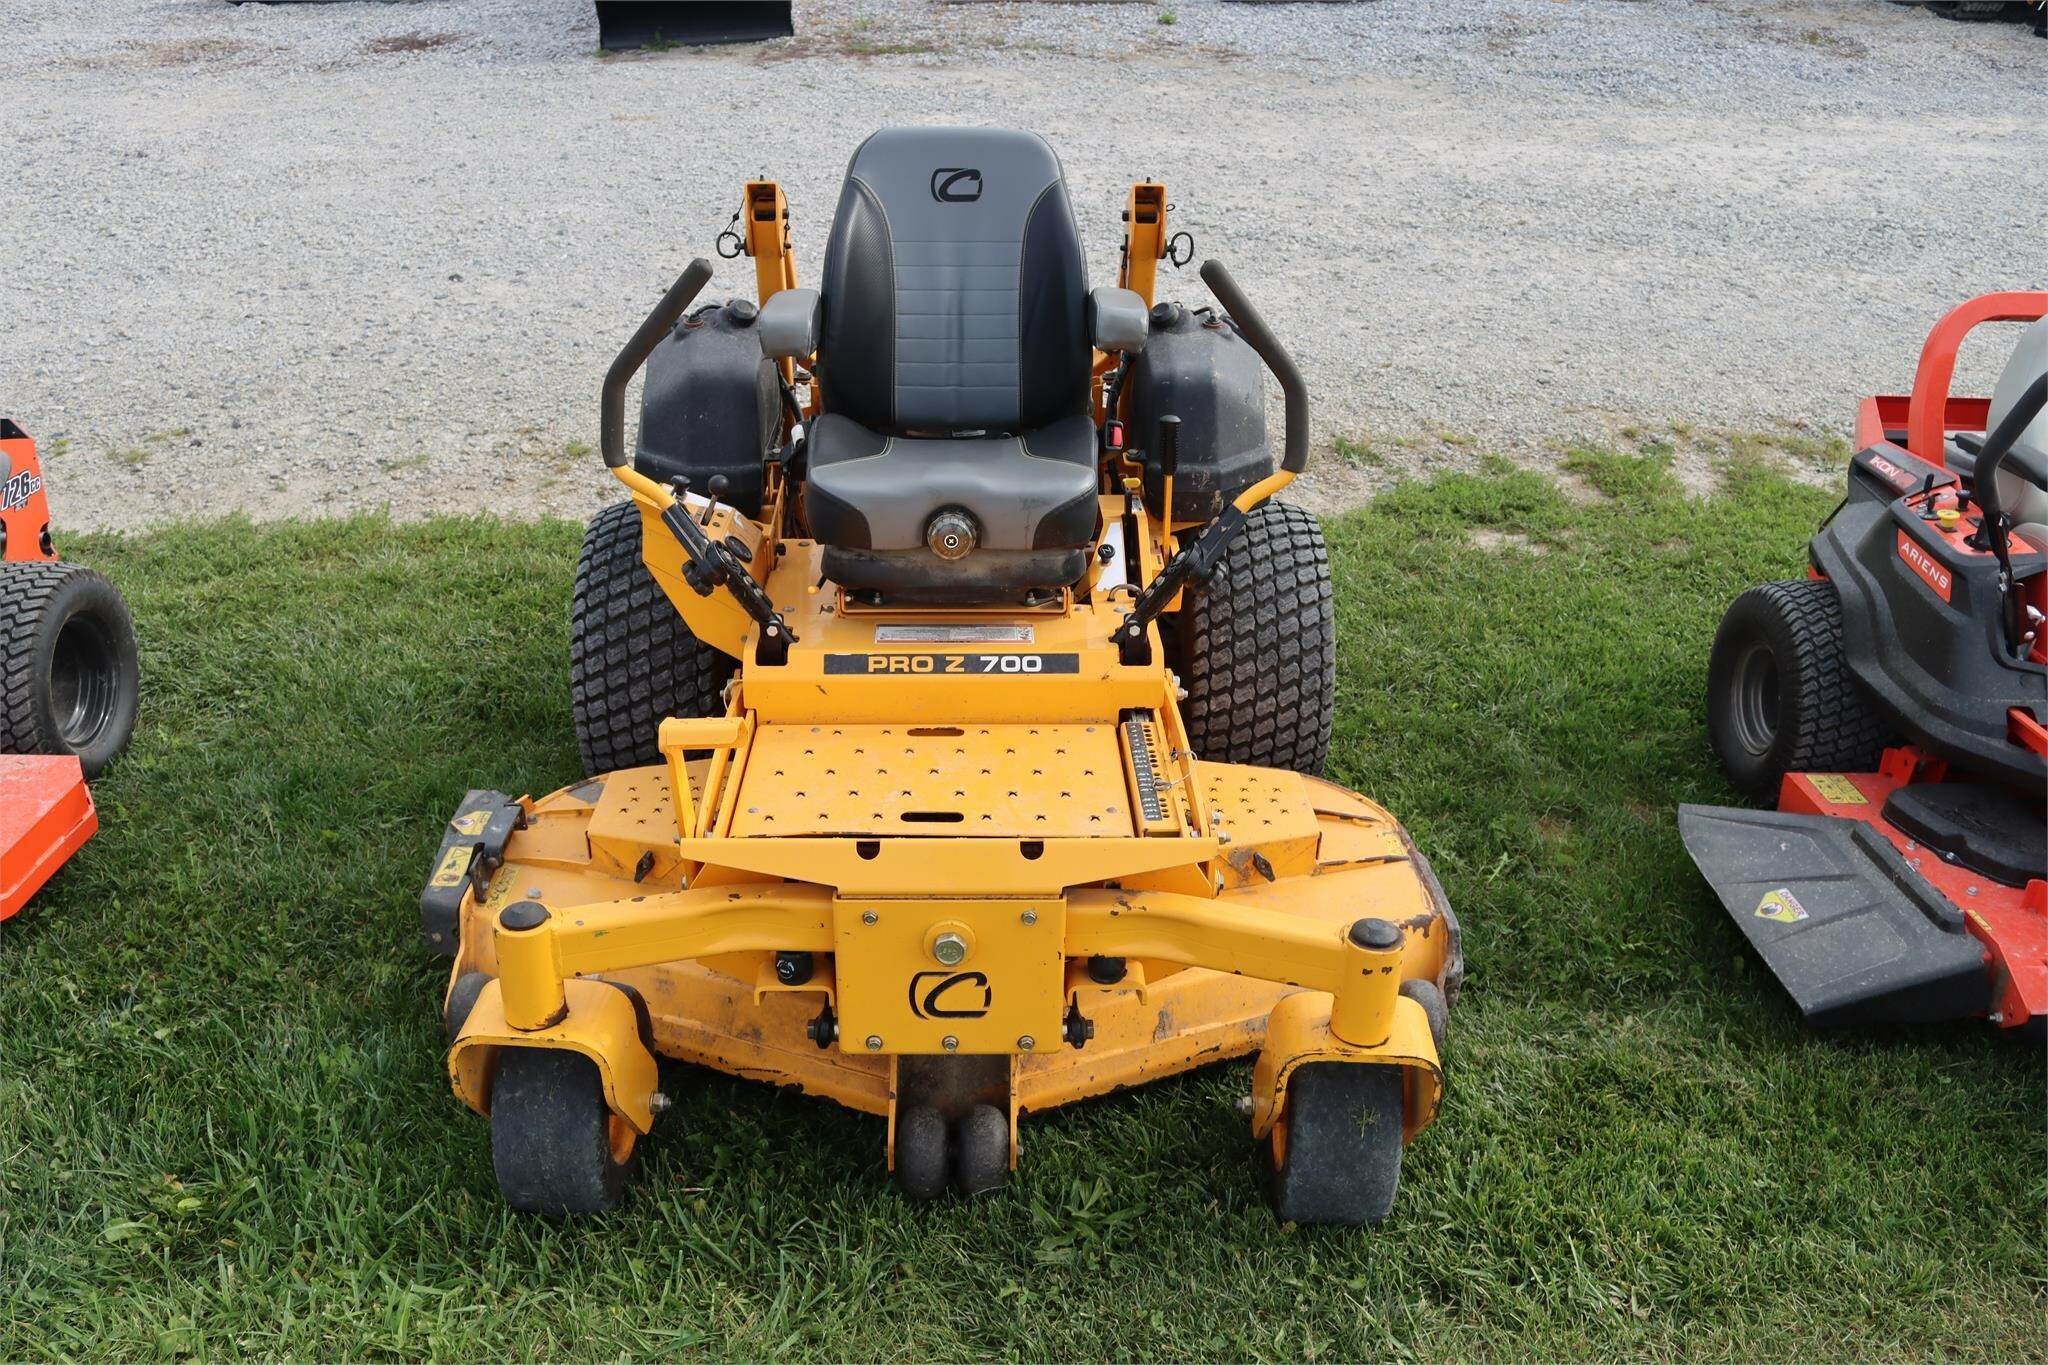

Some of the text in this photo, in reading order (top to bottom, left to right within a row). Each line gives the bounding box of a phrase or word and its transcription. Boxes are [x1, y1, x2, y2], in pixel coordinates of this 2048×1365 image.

[1901, 542, 1949, 589] ARIENS
[867, 655, 1042, 673] PRO Z 700
